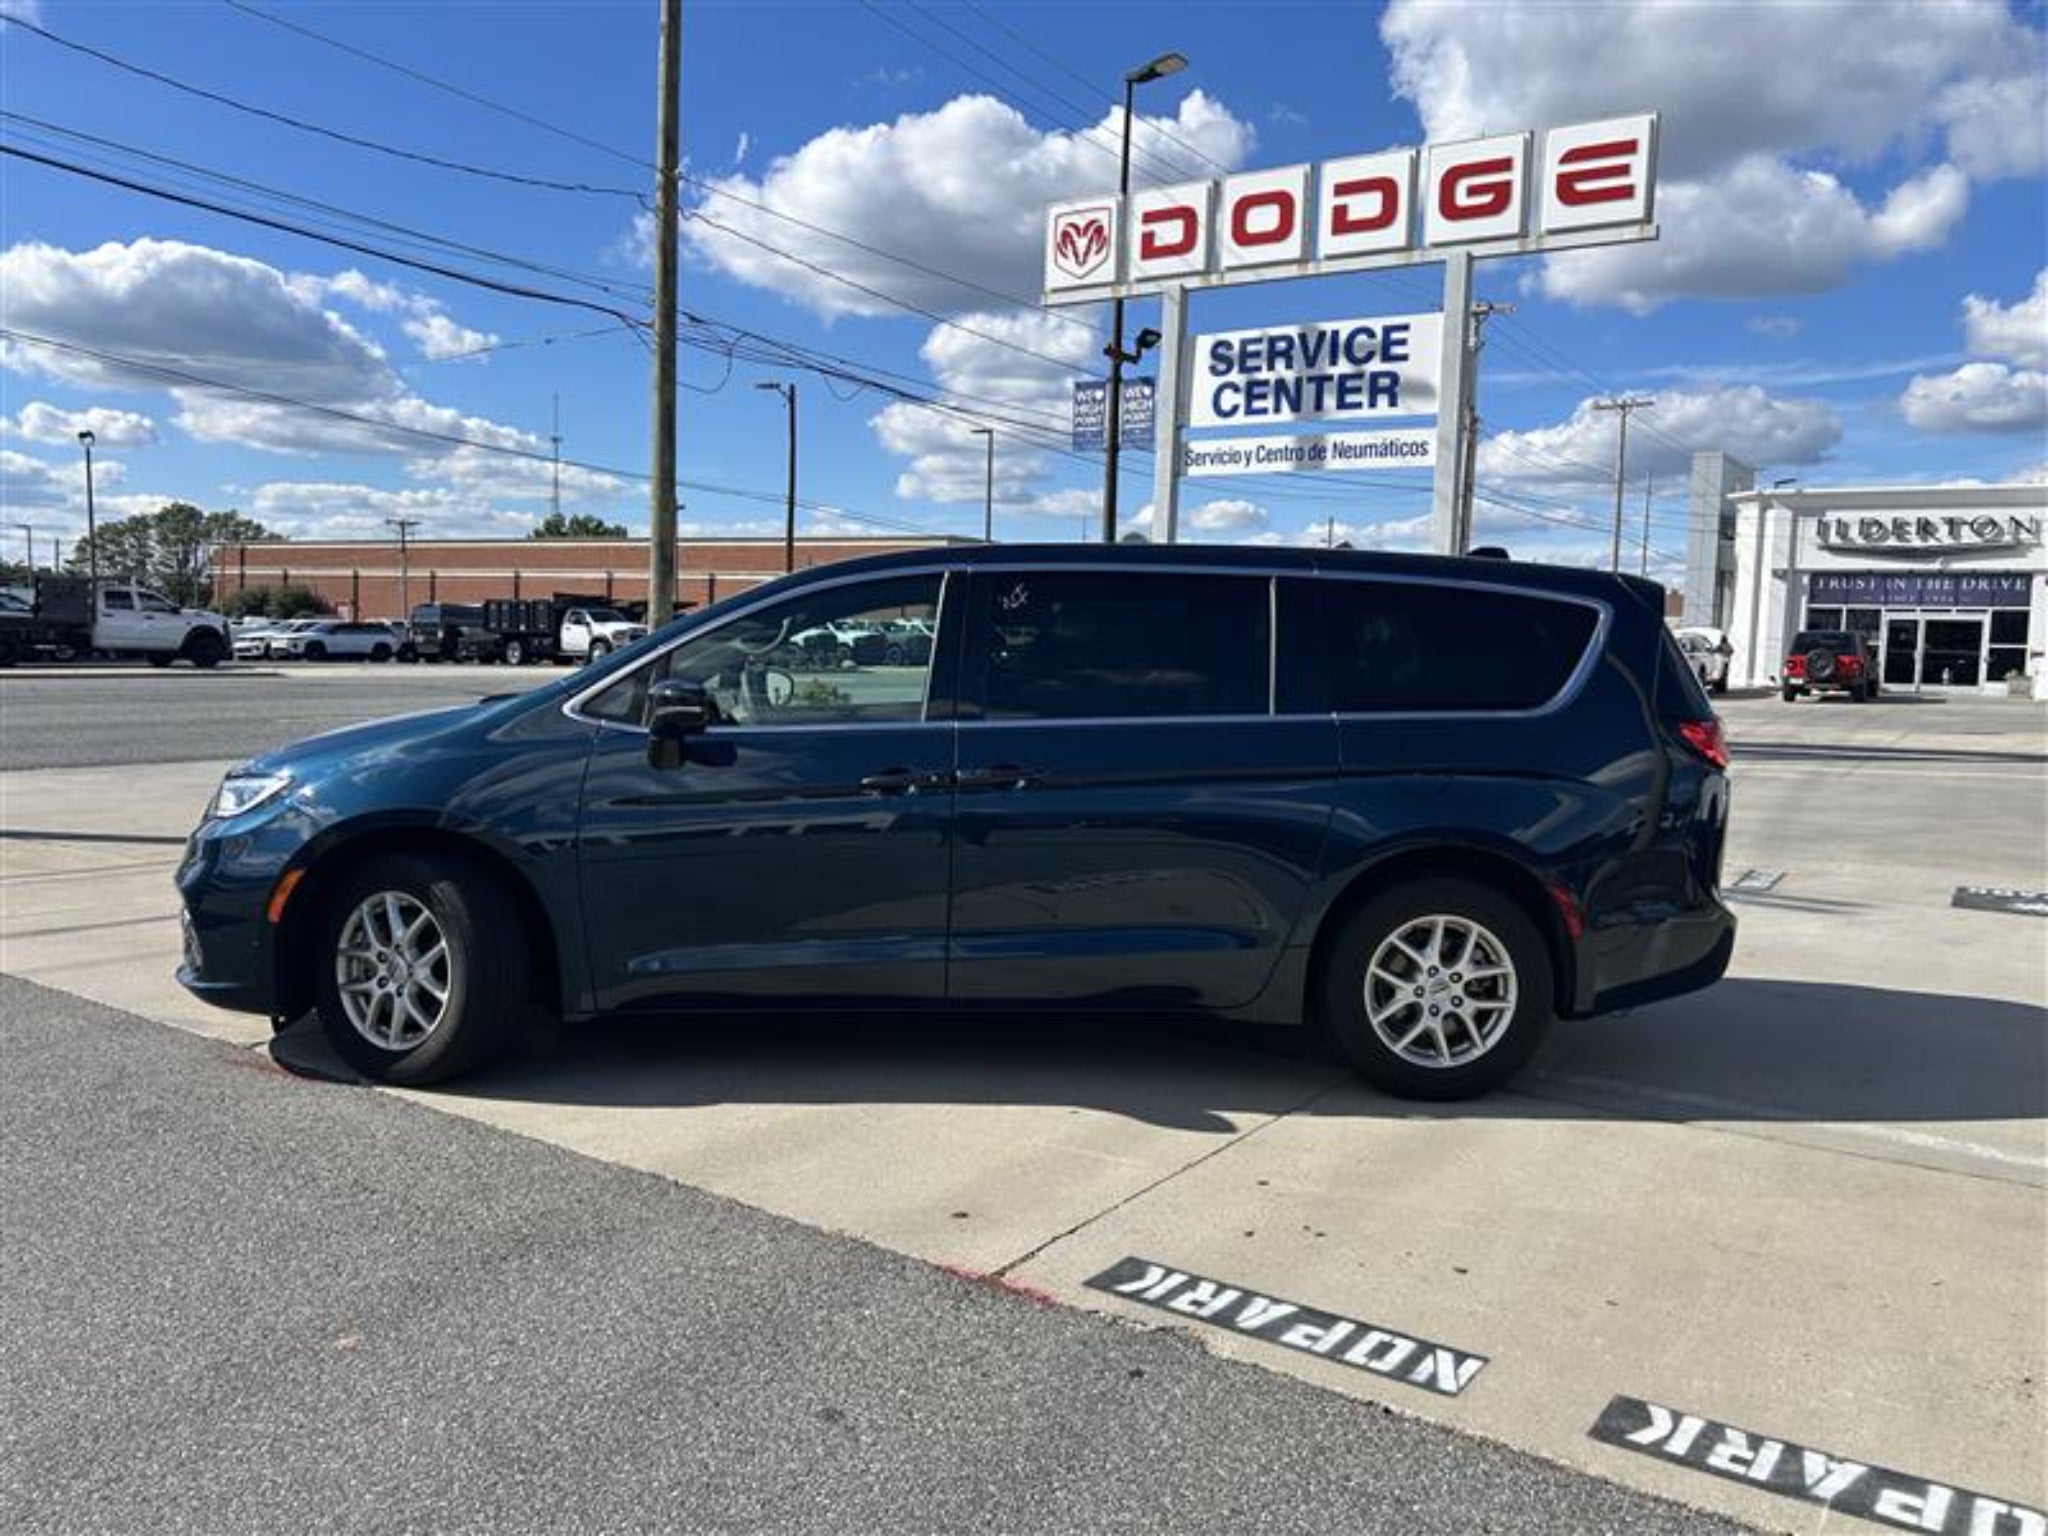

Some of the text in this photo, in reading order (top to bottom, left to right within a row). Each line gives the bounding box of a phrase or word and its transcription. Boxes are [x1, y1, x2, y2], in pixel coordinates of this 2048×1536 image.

[1140, 138, 1639, 260] DODGE
[1208, 323, 1411, 377] SERVICE
[1211, 370, 1401, 419] CENTER
[1185, 437, 1430, 467] Servicio y Centro de Neumáticos
[1816, 515, 2042, 544] ILDERTON
[1817, 576, 2027, 591] TRUST IN THE DRIVE
[1115, 1264, 1486, 1394] NOPARK
[1626, 1401, 2048, 1536] OPARK
